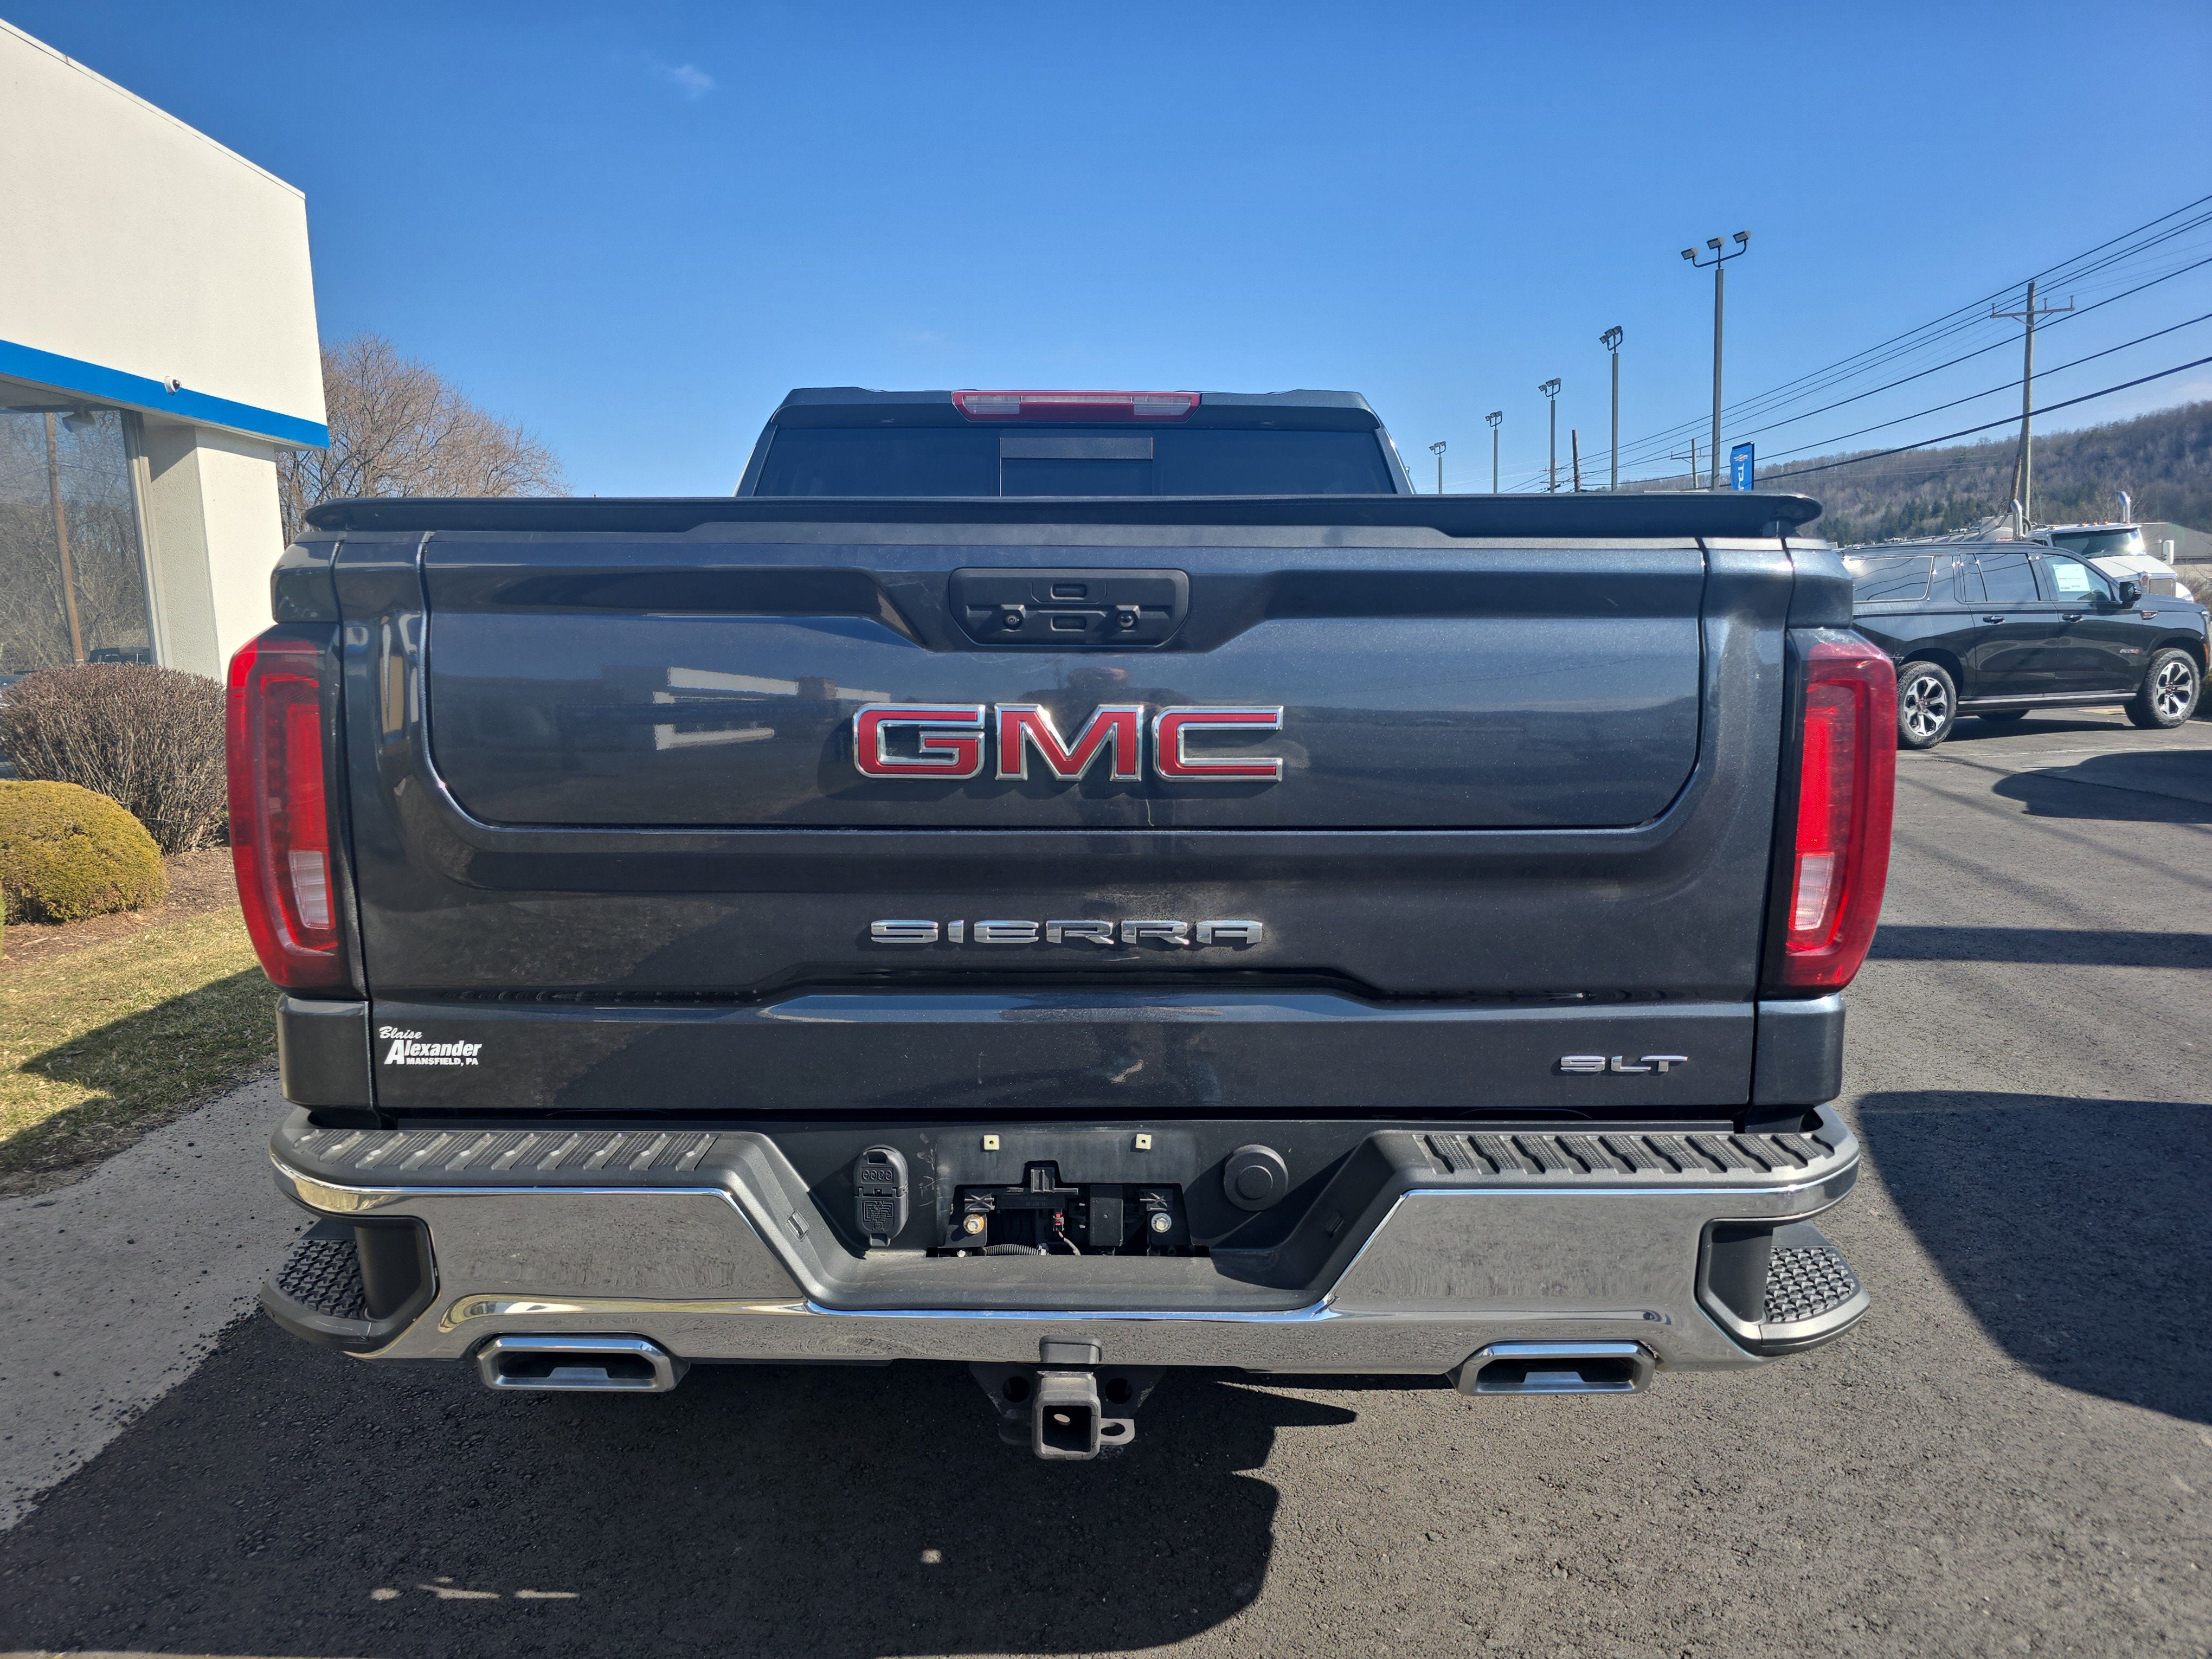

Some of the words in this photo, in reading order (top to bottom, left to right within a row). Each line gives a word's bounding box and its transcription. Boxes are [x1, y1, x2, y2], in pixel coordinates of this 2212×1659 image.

[852, 703, 1284, 782] GMC
[871, 920, 1263, 944] SIERRA
[379, 1026, 422, 1039] Blaise
[384, 1039, 482, 1065] Alexander
[406, 1057, 464, 1067] MANSFIELD,
[465, 1057, 479, 1065] PA
[1560, 1055, 1688, 1072] SLT
